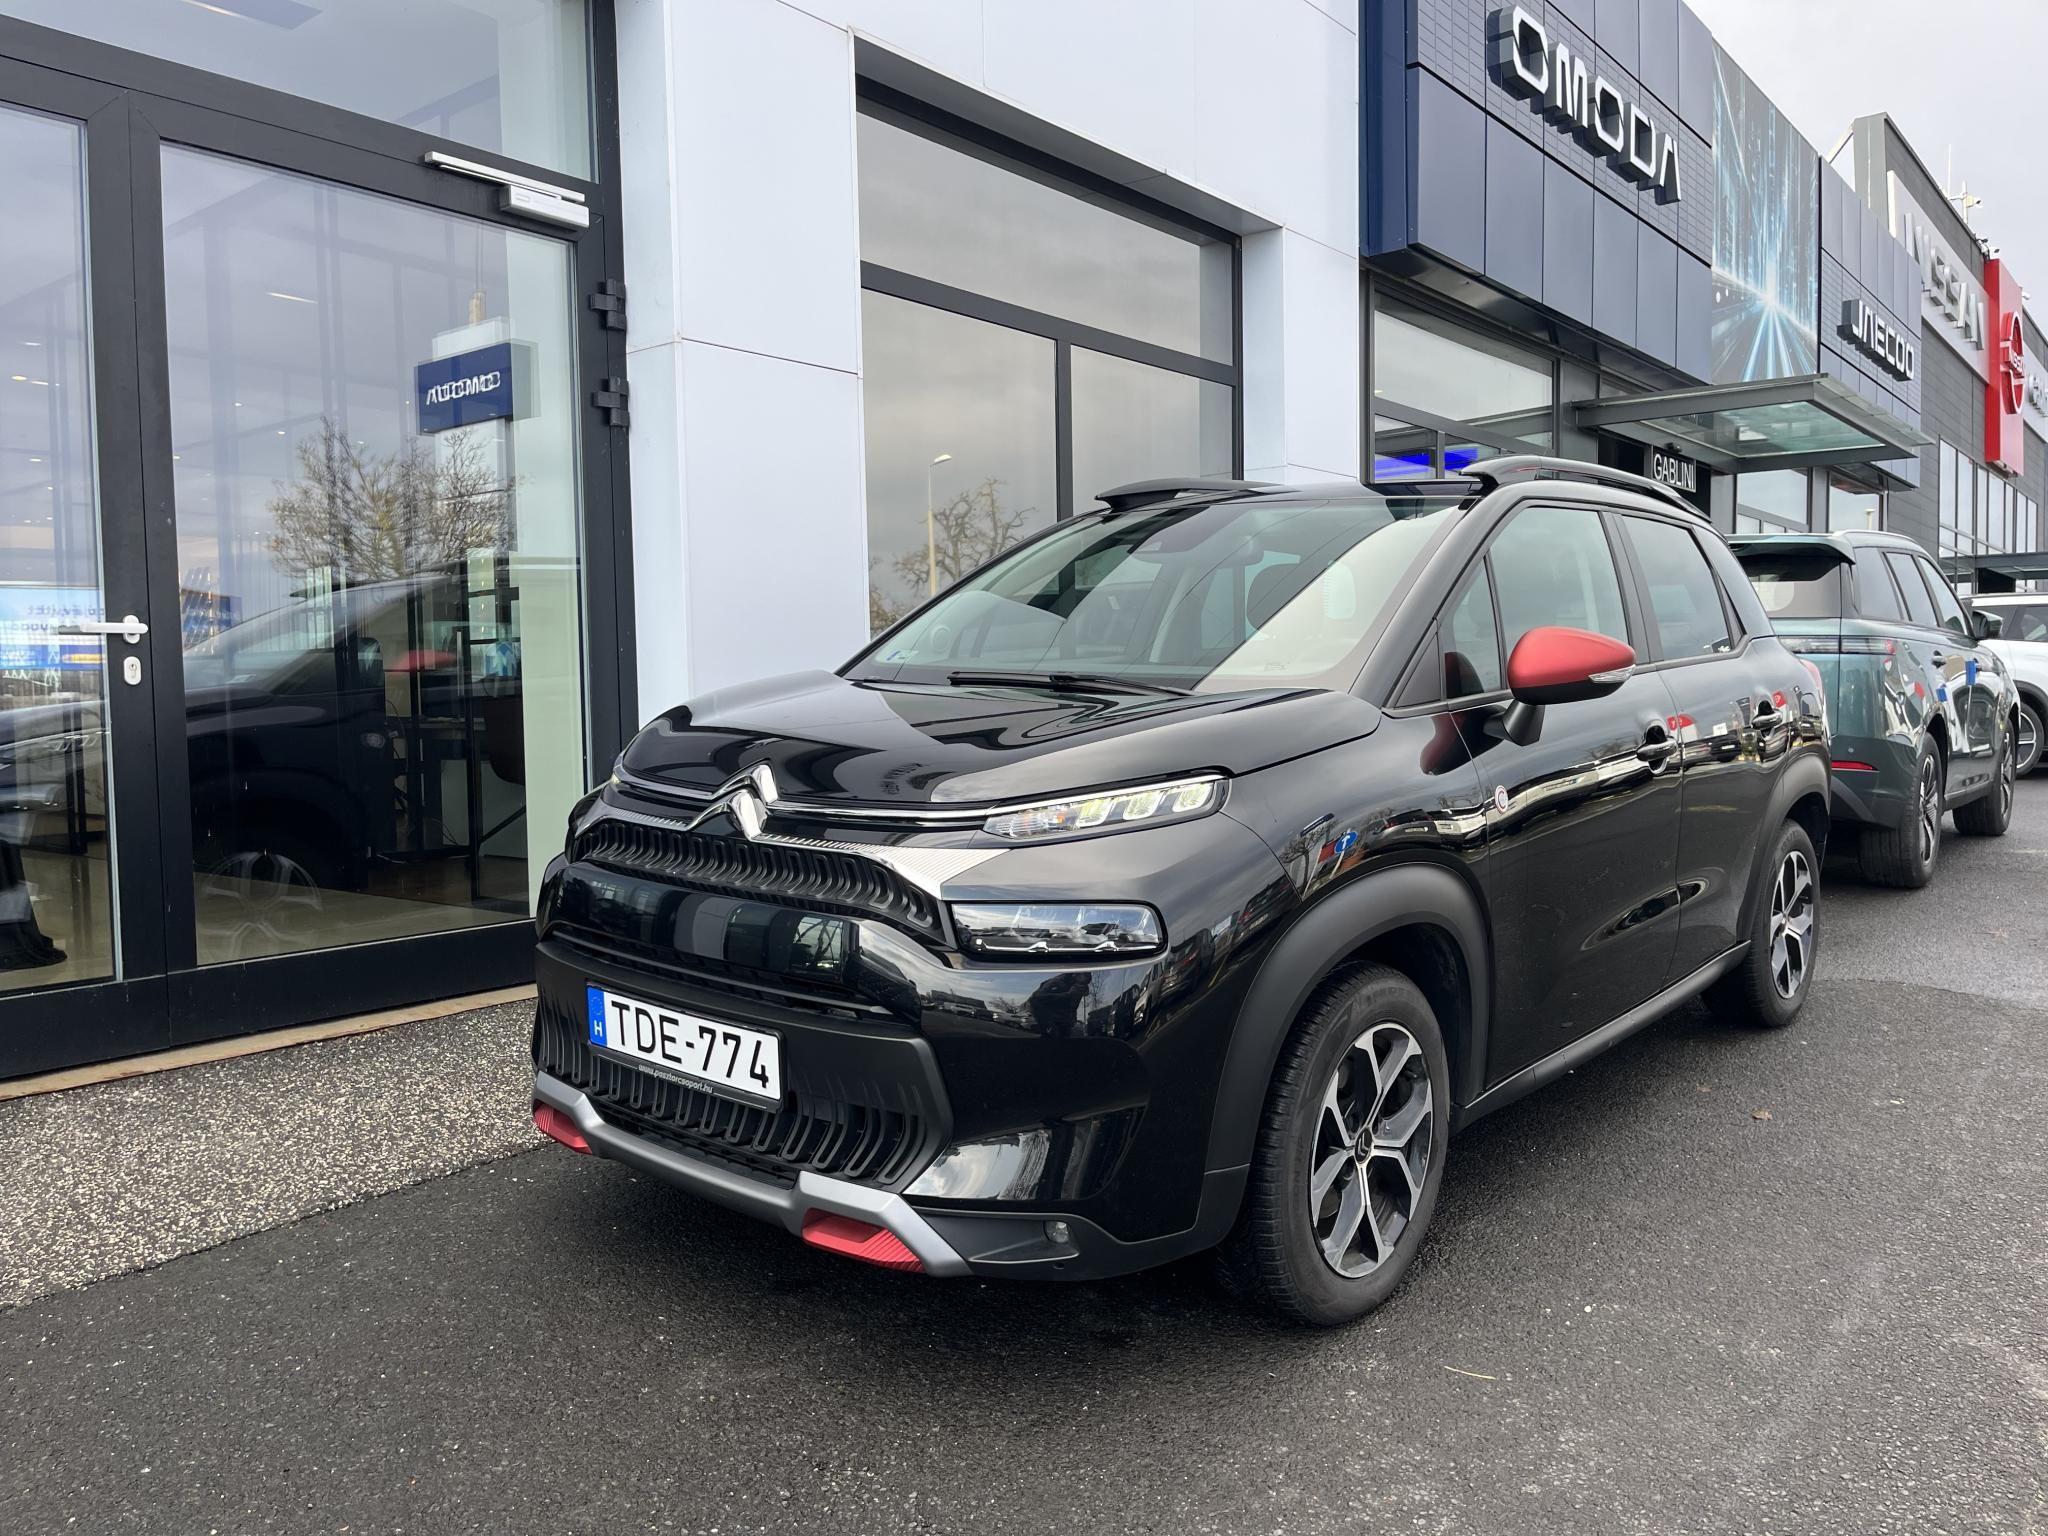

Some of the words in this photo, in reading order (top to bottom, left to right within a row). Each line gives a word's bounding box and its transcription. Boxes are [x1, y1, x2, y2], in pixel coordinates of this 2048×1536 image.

[1511, 5, 1682, 202] OMODA
[1904, 212, 1984, 350] NISSAN
[1852, 300, 1914, 379] JAECOO
[1653, 453, 1694, 489] GABLINI
[594, 1020, 603, 1037] H
[611, 1000, 769, 1089] TDE-774
